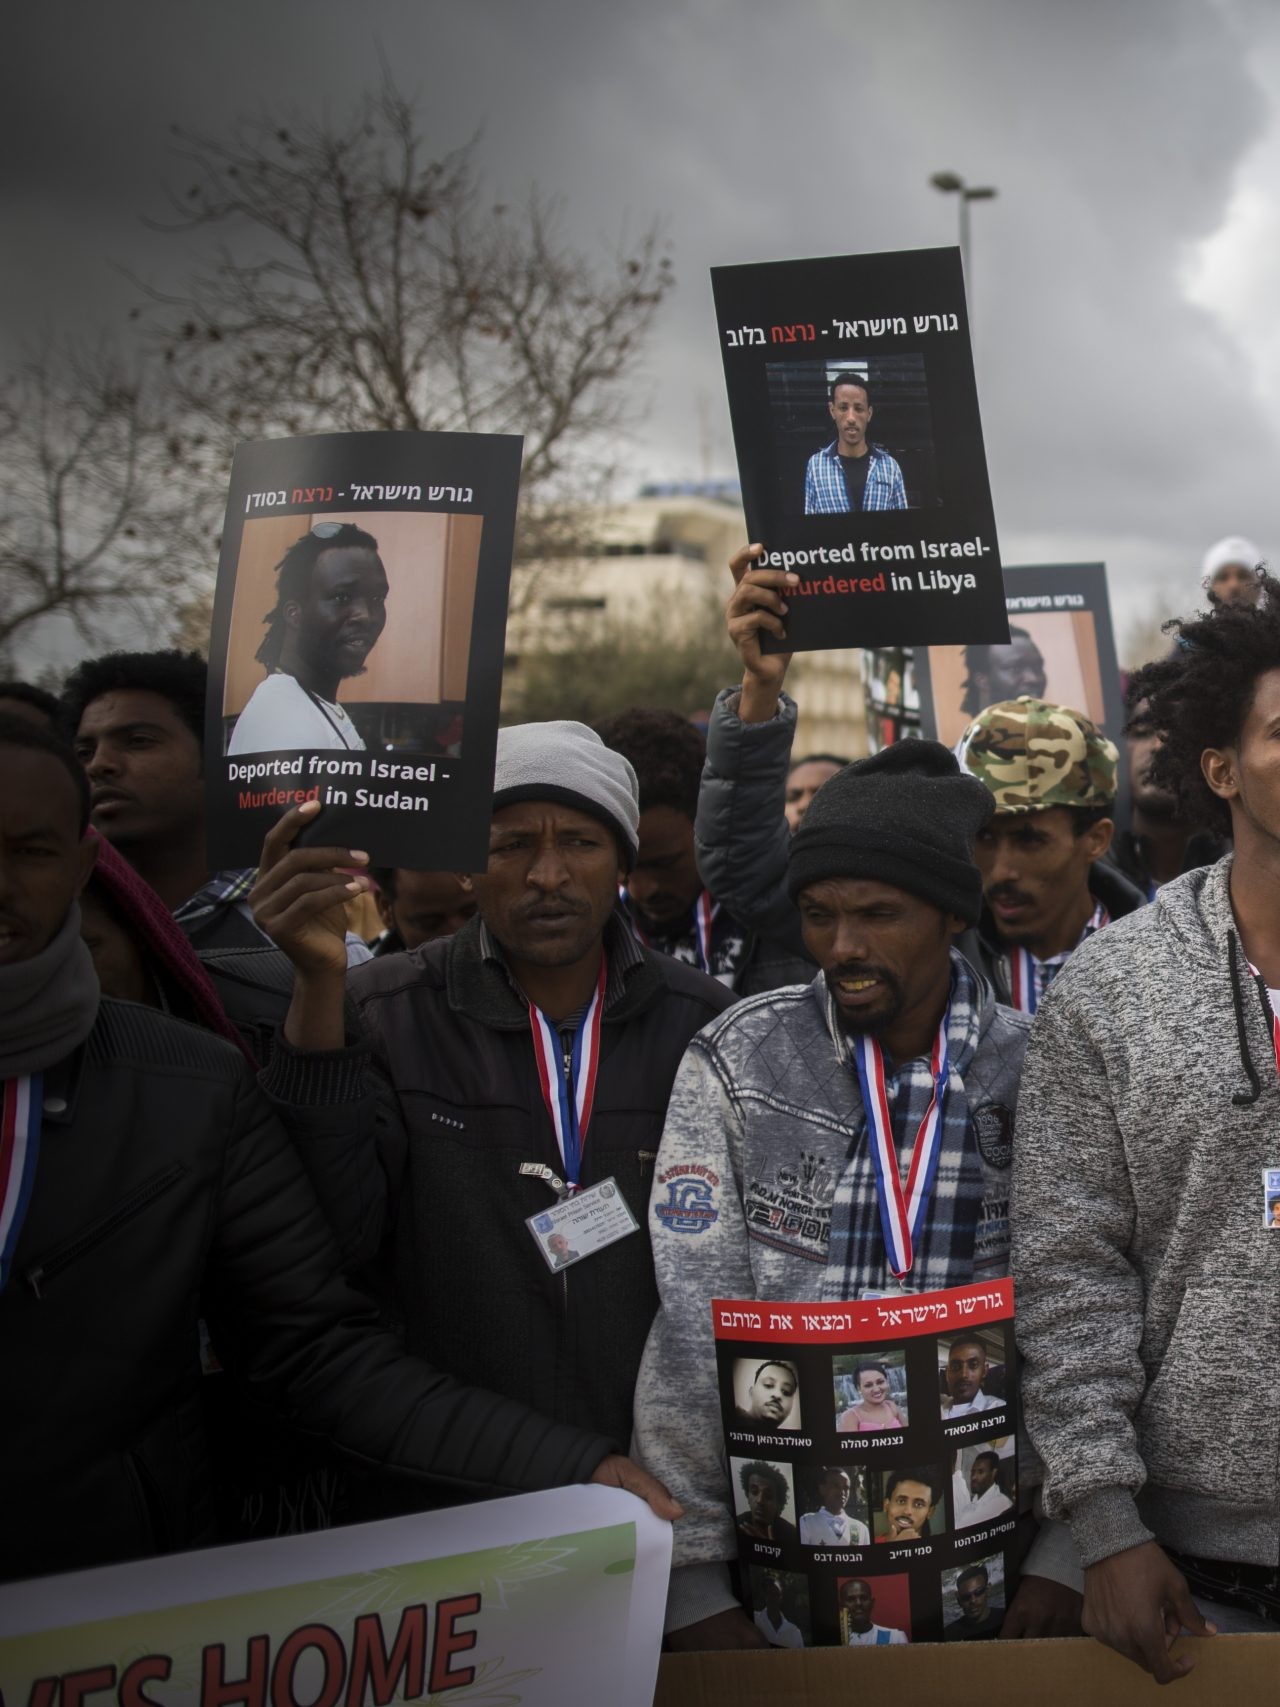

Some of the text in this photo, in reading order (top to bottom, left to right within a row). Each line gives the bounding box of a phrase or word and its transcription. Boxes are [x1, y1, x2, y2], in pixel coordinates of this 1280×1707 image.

[771, 323, 815, 343] נרצח
[833, 316, 907, 339] מישראל
[914, 313, 958, 333] גורש
[727, 326, 766, 346] בלוב
[246, 490, 286, 513] בסודן
[291, 486, 333, 504] נרצח
[350, 483, 420, 500] מישראל
[428, 485, 473, 502] גורש
[757, 536, 990, 571] Deported from Israel-
[891, 571, 913, 591] in
[917, 569, 976, 594] Libya
[228, 756, 303, 783] Deported
[308, 756, 362, 776] from
[370, 759, 436, 782] Israel
[239, 785, 429, 811] Murdered in Sudan
[955, 1291, 1003, 1316] גורשו
[720, 1311, 762, 1329] מותם
[769, 1312, 794, 1330] את
[801, 1313, 852, 1331] ומצאו
[877, 1302, 948, 1328] מישראל
[914, 1544, 932, 1558] סמי
[200, 1592, 482, 1707] HOME
